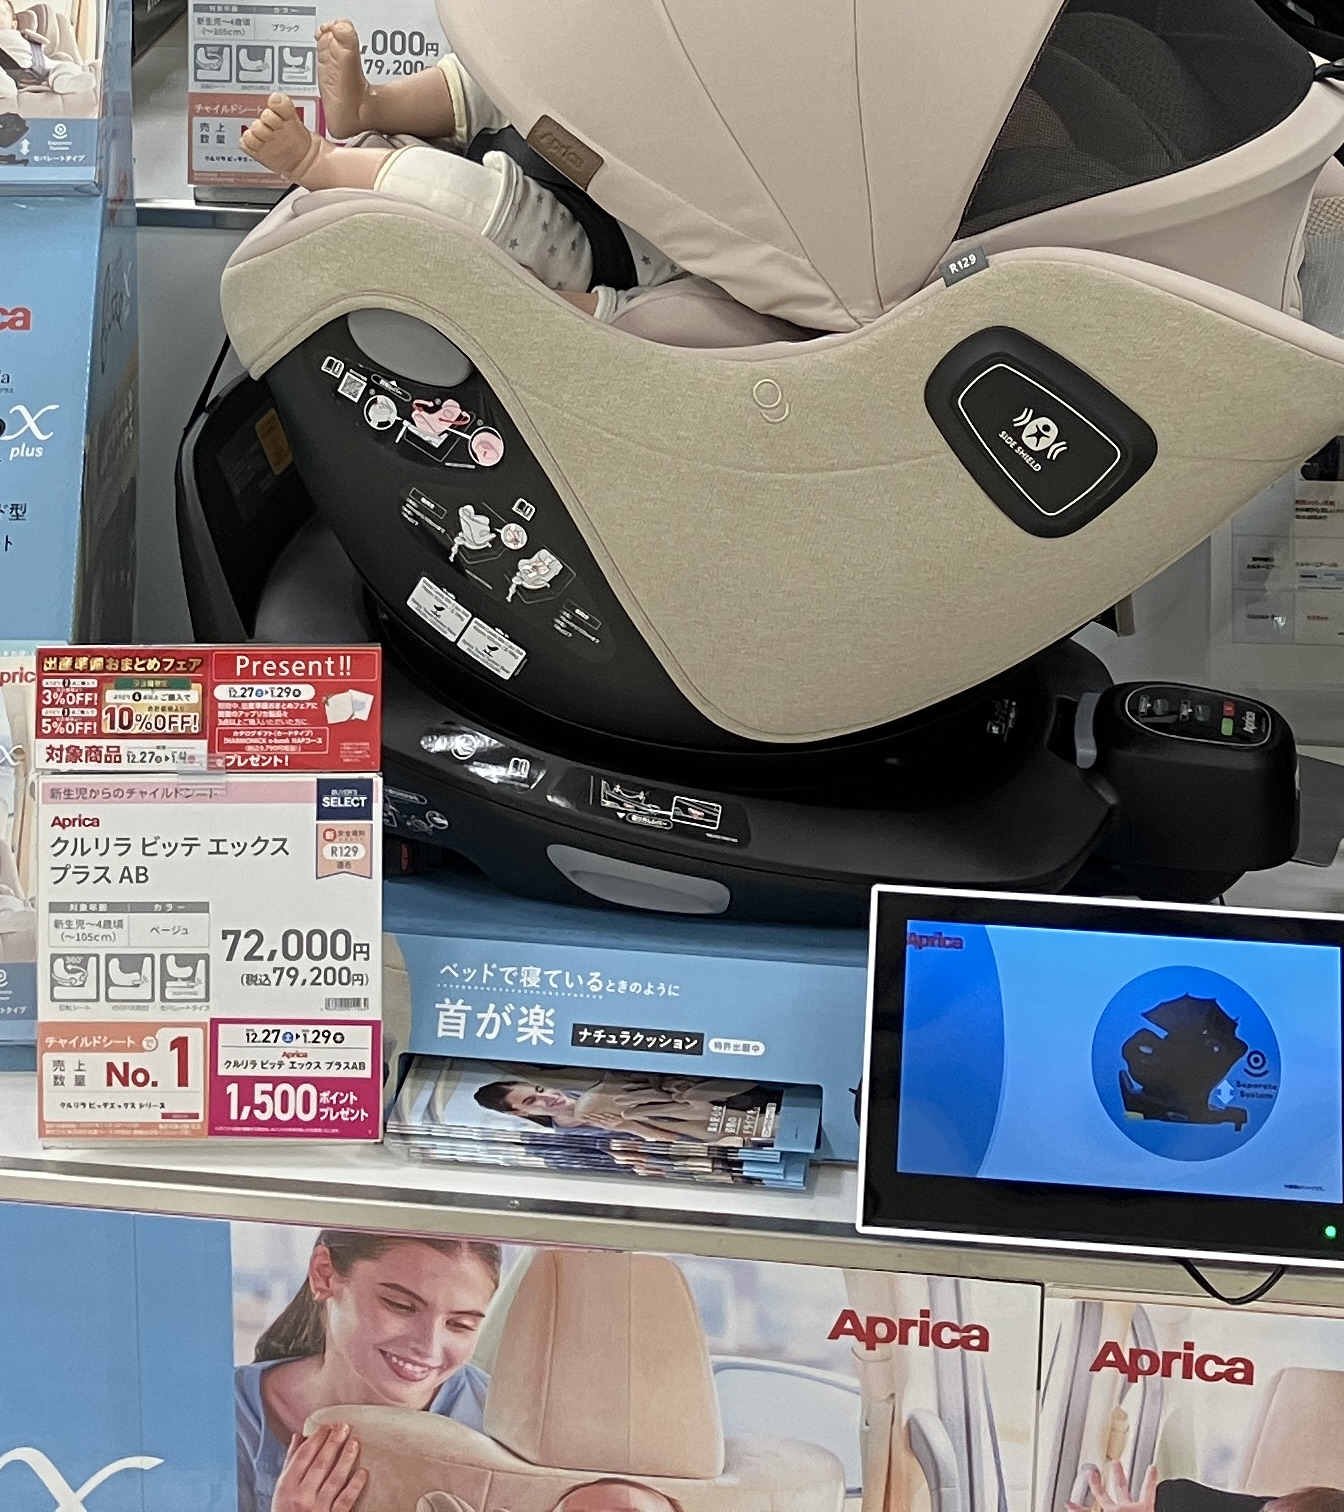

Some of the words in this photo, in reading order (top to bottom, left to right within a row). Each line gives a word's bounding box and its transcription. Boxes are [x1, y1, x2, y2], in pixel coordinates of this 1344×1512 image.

[949, 253, 977, 274] R129
[9, 443, 44, 461] plus
[999, 430, 1016, 449] SIDE
[1014, 446, 1042, 472] SHIELD
[43, 656, 202, 673] 出産準備おまとめフェア
[236, 655, 352, 677] Present!!
[42, 689, 98, 706] 3%OFF!
[42, 719, 98, 735] 5%OFF!
[104, 706, 200, 732] 10%OFF!
[45, 745, 122, 764] 対象商品
[322, 796, 367, 808] SELECT
[50, 814, 100, 829] Aprica
[50, 836, 132, 858] クルリラ
[141, 836, 201, 857] ビッテ
[207, 838, 290, 857] エックス
[330, 845, 359, 858] R129
[50, 863, 112, 885] プラス
[119, 866, 149, 884] AB
[150, 925, 189, 935] ベージュ
[221, 928, 370, 962] 72,000円
[437, 960, 681, 1000] ベッドで寝ているときのように
[434, 997, 557, 1046] 首が楽
[45, 1036, 135, 1048] チャイルドシート
[577, 1027, 700, 1053] ナチュラクッション
[106, 1062, 158, 1087] No.
[169, 1036, 189, 1087] 1
[226, 1082, 317, 1121] 1,500
[319, 1091, 358, 1104] ポイント
[319, 1107, 369, 1122] プレゼント
[827, 1308, 990, 1352] Aprica
[1090, 1340, 1256, 1386] Aprica
